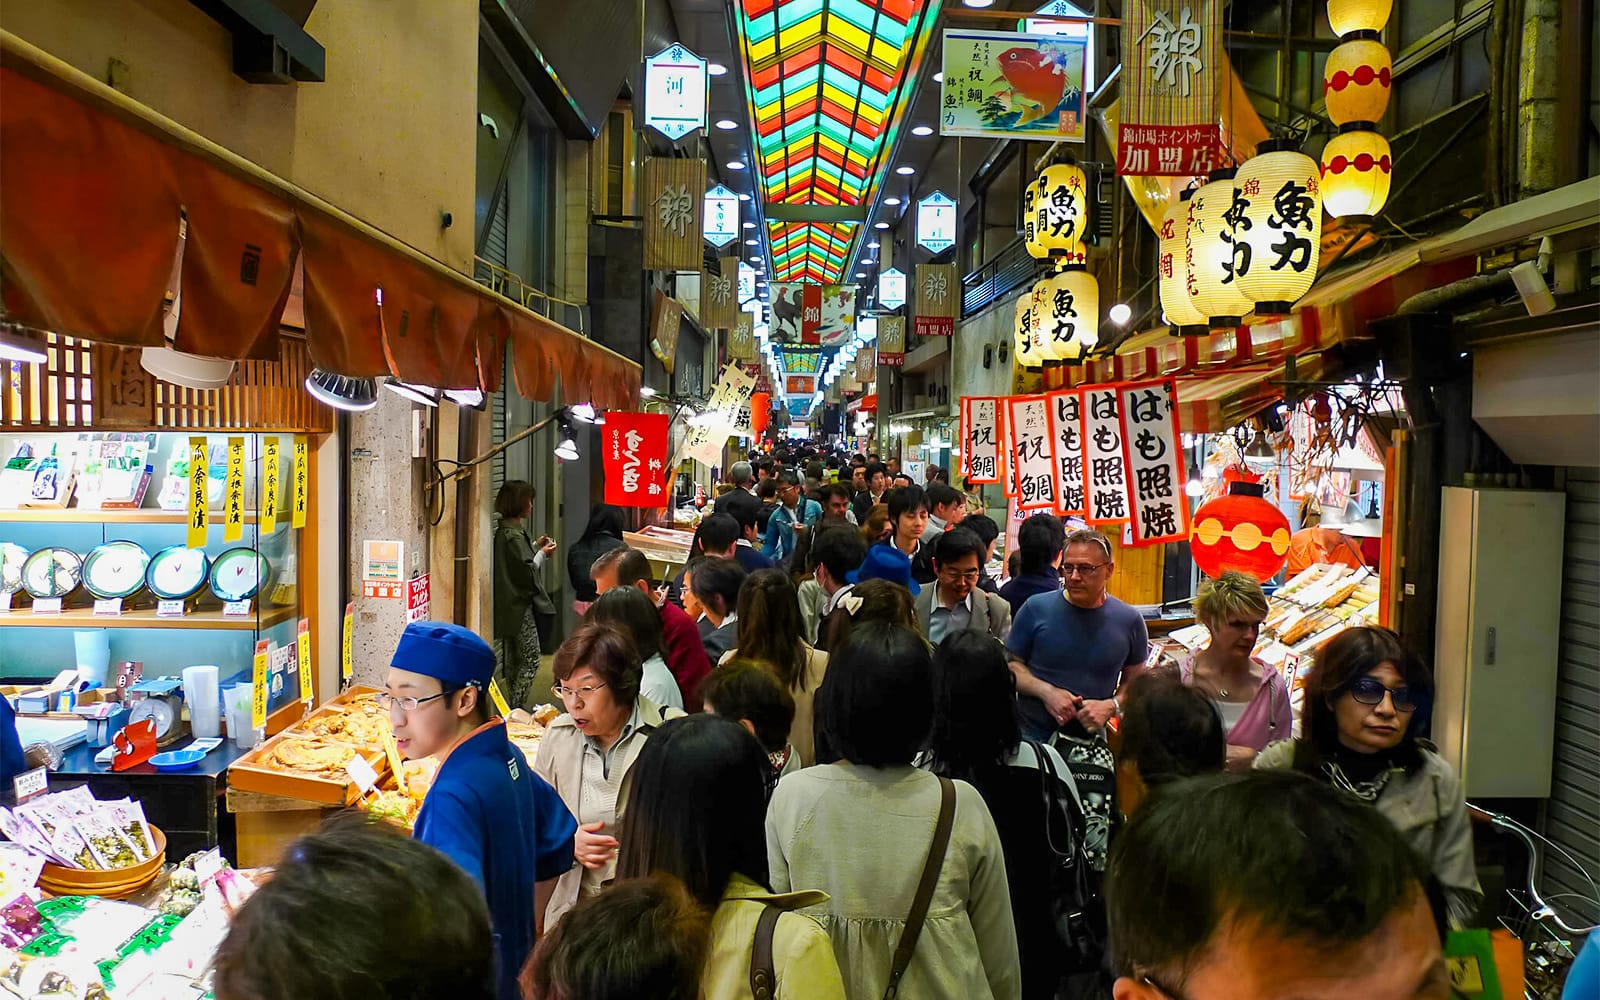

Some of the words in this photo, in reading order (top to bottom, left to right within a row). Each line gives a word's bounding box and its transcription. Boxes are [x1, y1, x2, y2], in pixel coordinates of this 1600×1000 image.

[1136, 7, 1203, 97] 錦
[967, 67, 984, 103] 祝鯛
[1121, 144, 1216, 175] 加盟店
[1123, 127, 1216, 146] 錦市場ポイントカード
[650, 184, 693, 239] 錦
[1050, 185, 1077, 238] 魚力
[1243, 177, 1260, 197] 錦
[1268, 180, 1316, 273] 魚力
[710, 273, 732, 307] 錦
[804, 306, 820, 323] 錦
[920, 272, 947, 305] 錦
[1052, 288, 1078, 342] 魚力
[296, 443, 305, 512] 胡瓜奈良漬
[971, 423, 996, 478] 祝鯛
[1017, 433, 1054, 504] 祝鯛
[1058, 396, 1084, 511] はも照焼
[1091, 391, 1125, 519] はも照焼
[1130, 389, 1177, 539] はも照焼
[193, 444, 206, 529] 瓜奈良漬
[229, 444, 242, 524] 守口大根奈良漬
[265, 444, 277, 517] 西瓜奈良漬
